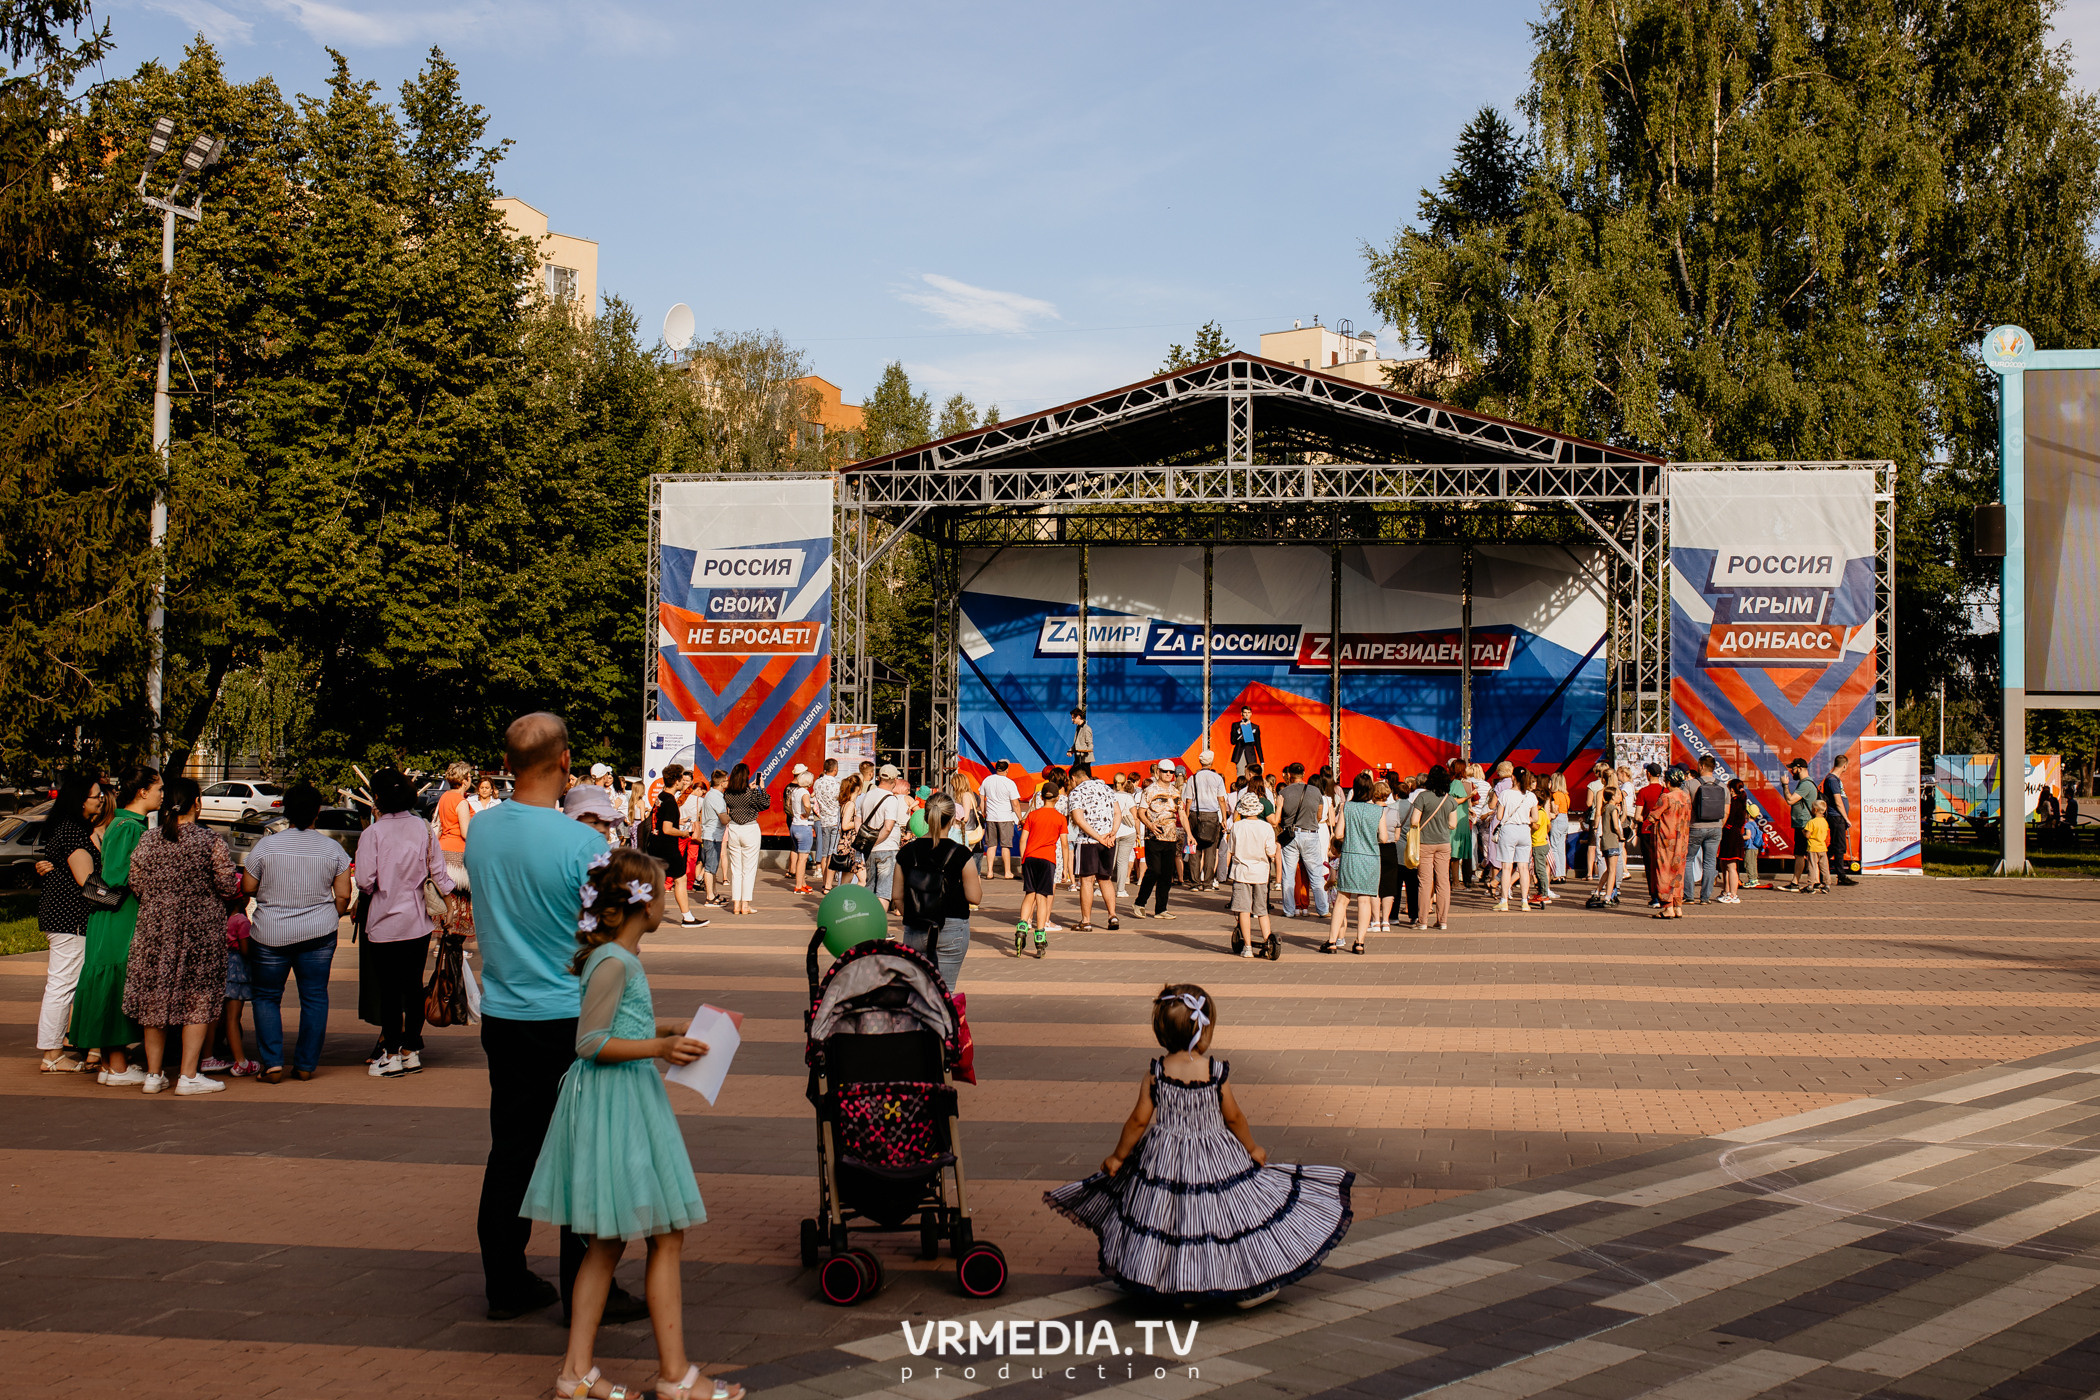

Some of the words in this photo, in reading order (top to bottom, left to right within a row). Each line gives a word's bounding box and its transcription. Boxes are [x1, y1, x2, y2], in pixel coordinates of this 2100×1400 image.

[703, 558, 793, 576] РОССИЯ
[1727, 554, 1833, 575] РОССИЯ
[709, 596, 778, 613] СВОИХ
[1738, 595, 1814, 615] КРЫМ
[687, 628, 716, 645] НЕ
[718, 628, 811, 645] БРОСАЕТ!
[1088, 626, 1141, 642] МИР!
[1192, 633, 1297, 651] РОССИЮ!
[1719, 631, 1833, 653] ДОНБАСС
[1355, 643, 1503, 663] ПРЕЗИДЕНТА!
[761, 755, 781, 781] ССИЮ!
[785, 701, 824, 749] ПРЕЗИДЕНТА!
[1863, 804, 1917, 813] Объединение
